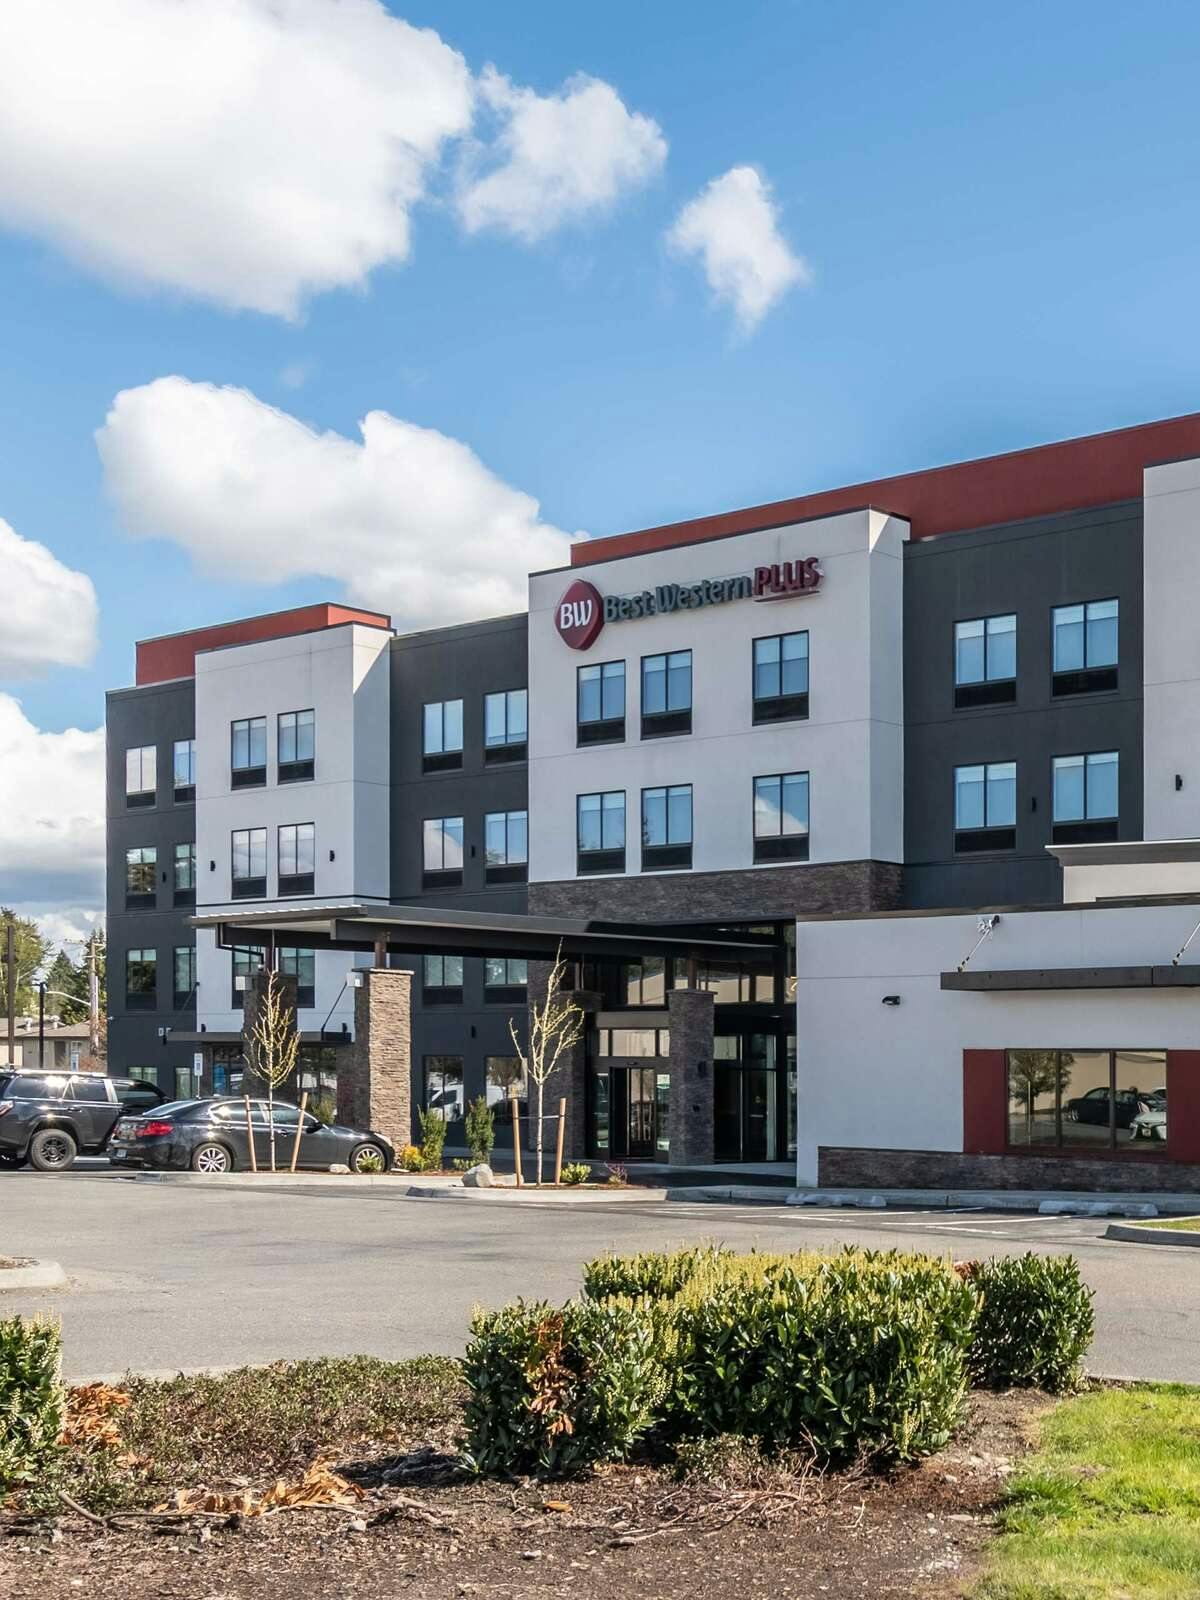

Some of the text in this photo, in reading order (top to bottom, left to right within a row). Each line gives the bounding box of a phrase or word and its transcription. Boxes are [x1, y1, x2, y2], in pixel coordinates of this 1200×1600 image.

[603, 557, 819, 622] Best Western PLUS
[560, 599, 592, 630] BW
